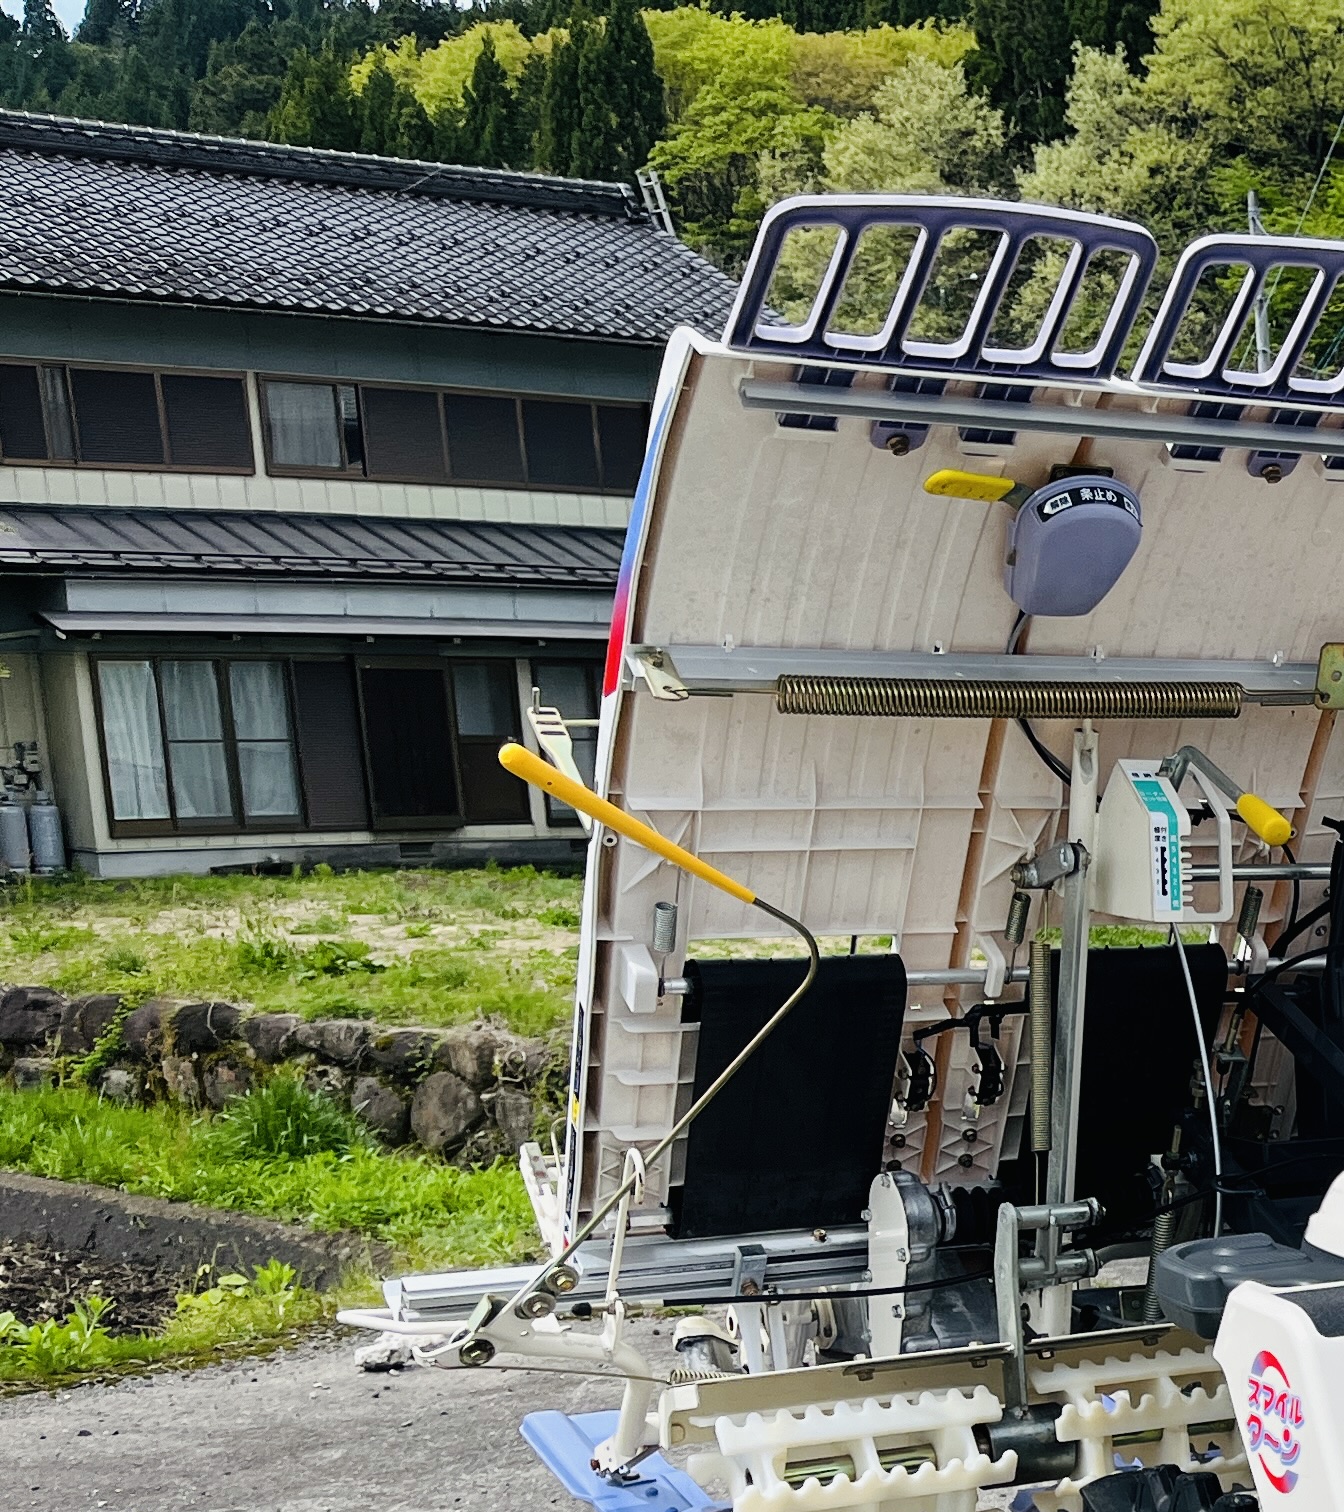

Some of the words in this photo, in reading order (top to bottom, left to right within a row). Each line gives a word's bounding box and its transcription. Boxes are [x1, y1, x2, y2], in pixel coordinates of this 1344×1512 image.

[1080, 488, 1117, 502] 条止め
[1248, 1376, 1304, 1427] スマイル
